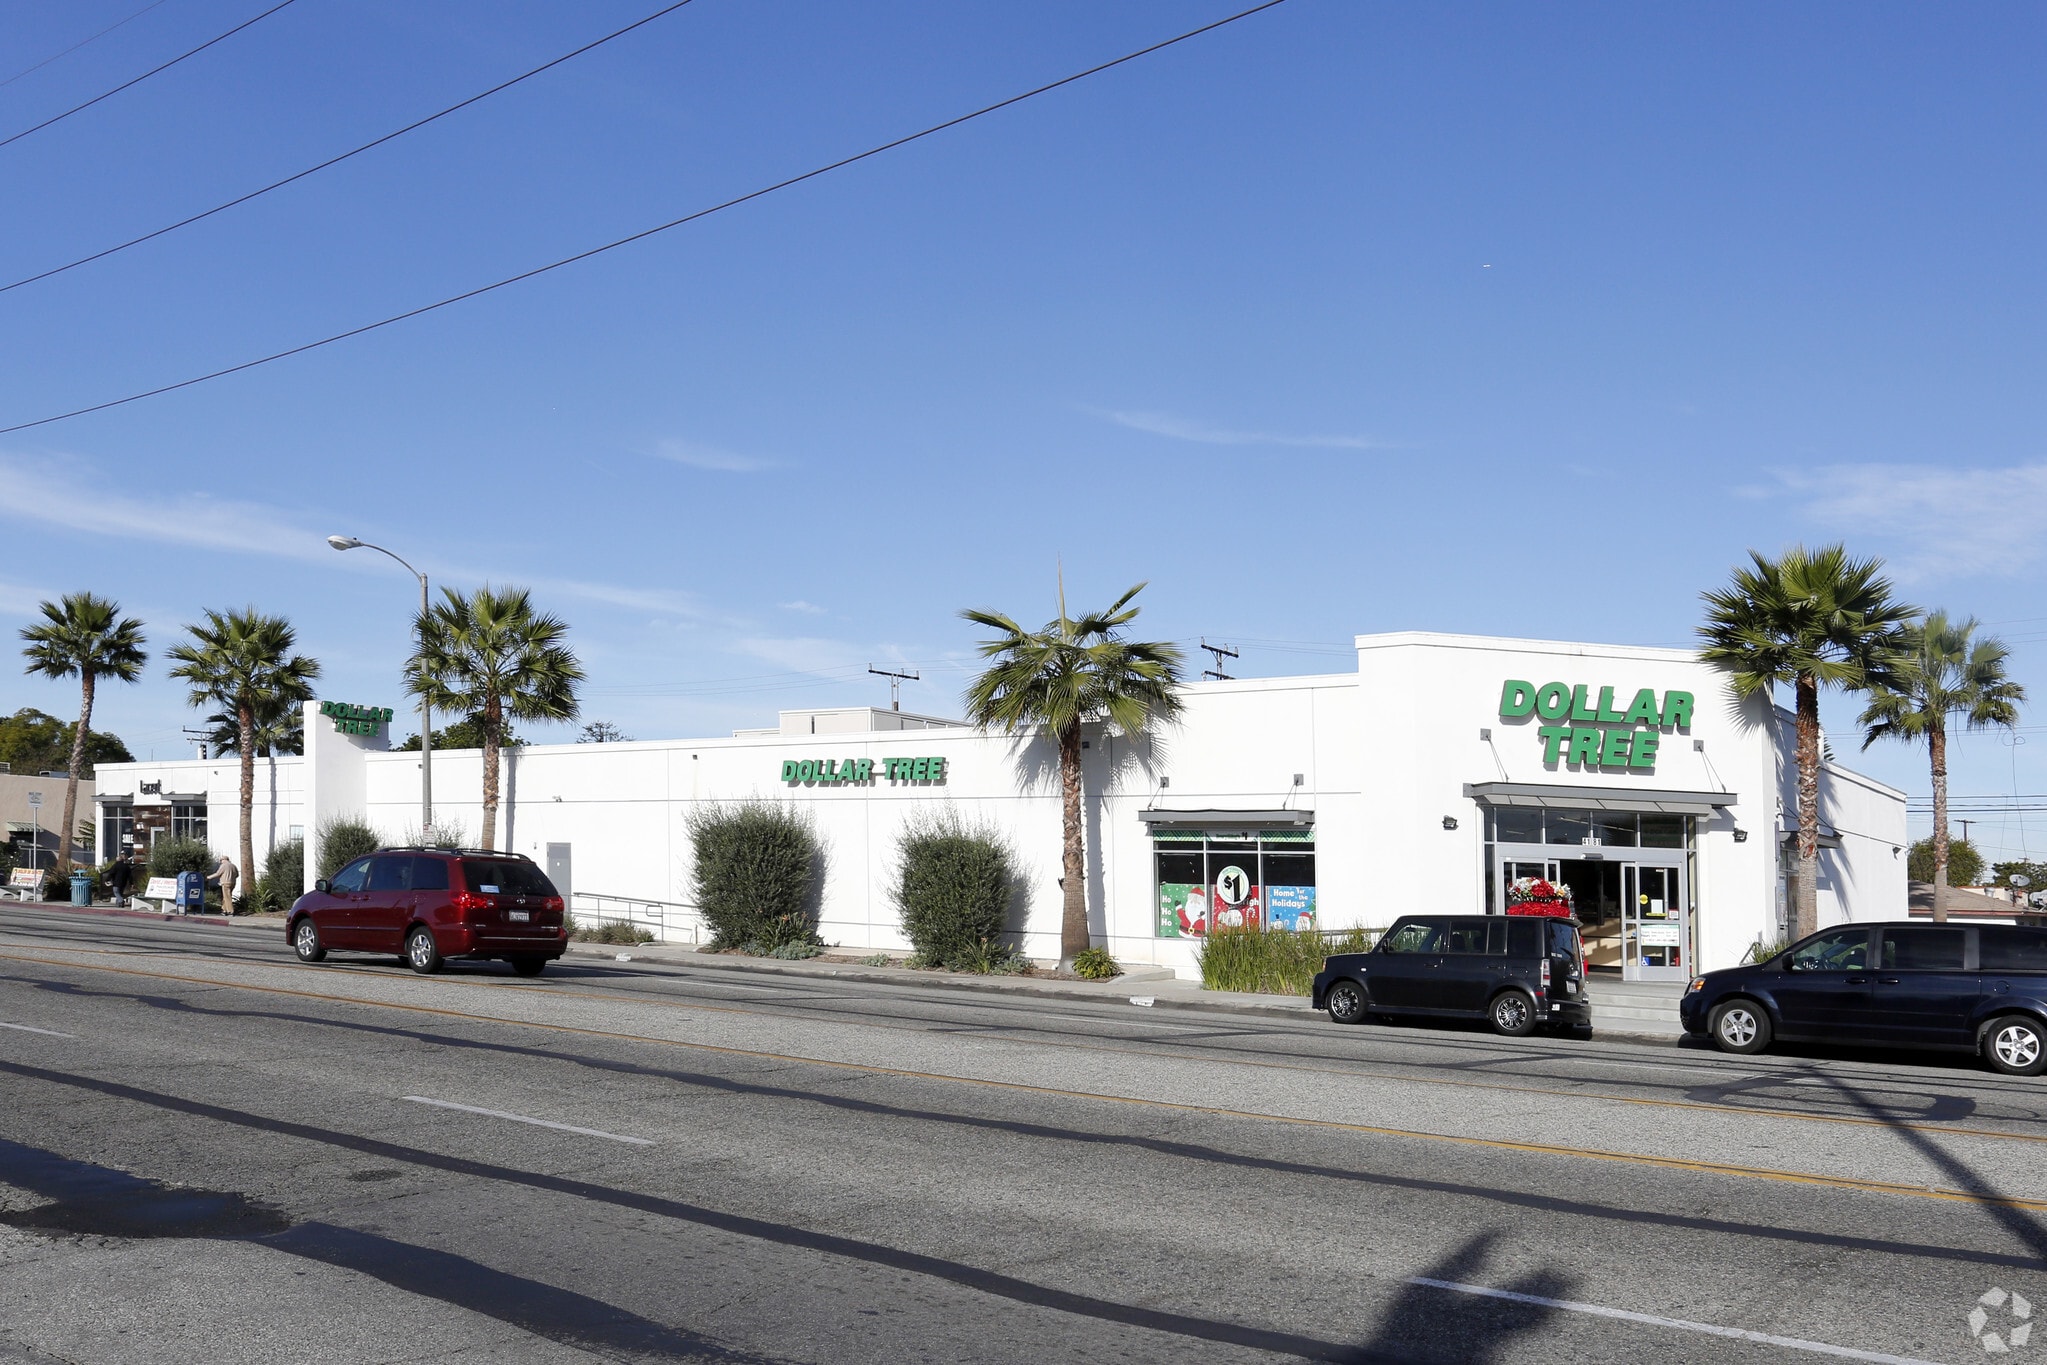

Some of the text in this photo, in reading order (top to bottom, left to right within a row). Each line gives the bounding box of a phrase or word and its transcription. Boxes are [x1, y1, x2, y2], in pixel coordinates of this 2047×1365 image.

[321, 701, 394, 722] DOLLAR
[1499, 679, 1695, 729] DOLLAR
[335, 718, 381, 737] TREE
[1538, 725, 1660, 768] TREE
[781, 757, 947, 782] DOLLAR TREE
[1223, 874, 1242, 903] $1
[1273, 889, 1295, 897] Home
[1162, 895, 1172, 904] Ho
[1271, 899, 1306, 909] Holidays
[1161, 907, 1172, 916] Ho
[1161, 918, 1173, 927] Ho
